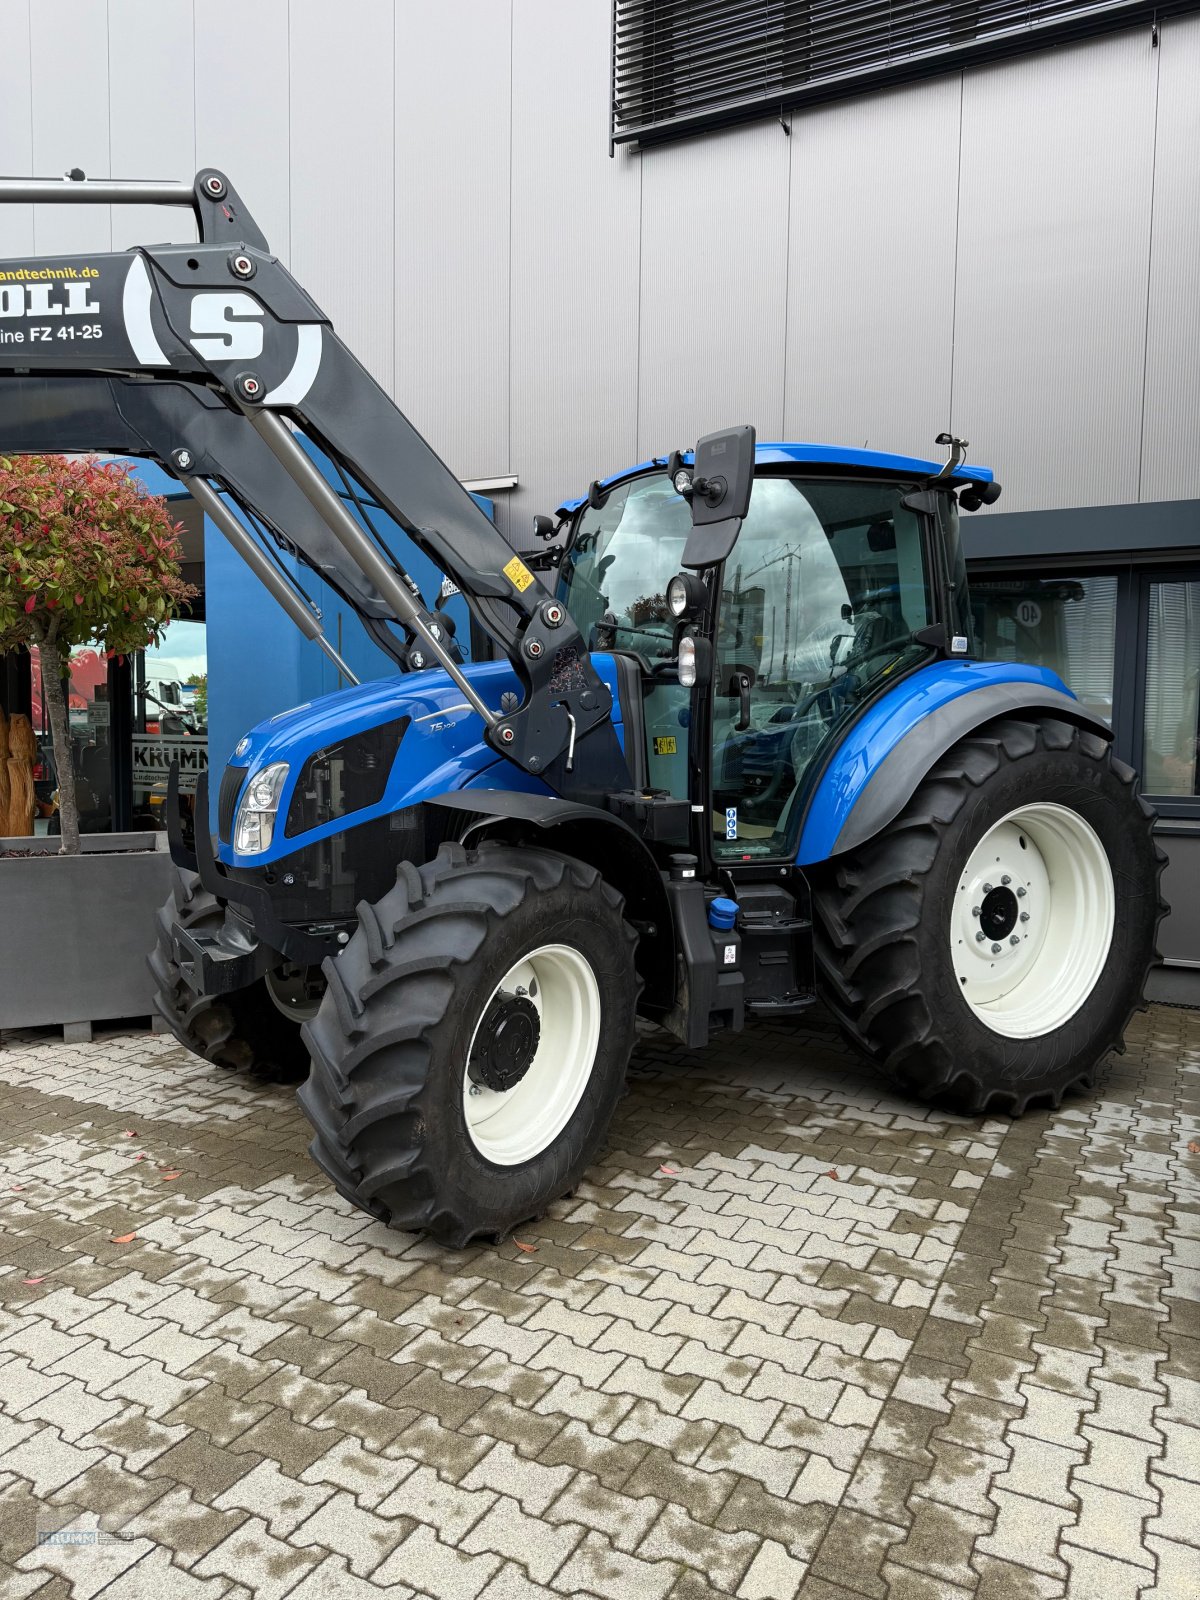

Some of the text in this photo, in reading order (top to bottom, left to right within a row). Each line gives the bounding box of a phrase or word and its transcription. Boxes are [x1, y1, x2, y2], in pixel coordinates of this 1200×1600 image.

[0, 282, 99, 317] OLL
[30, 327, 52, 341] FZ
[57, 325, 102, 340] 41-25
[190, 293, 264, 360] S
